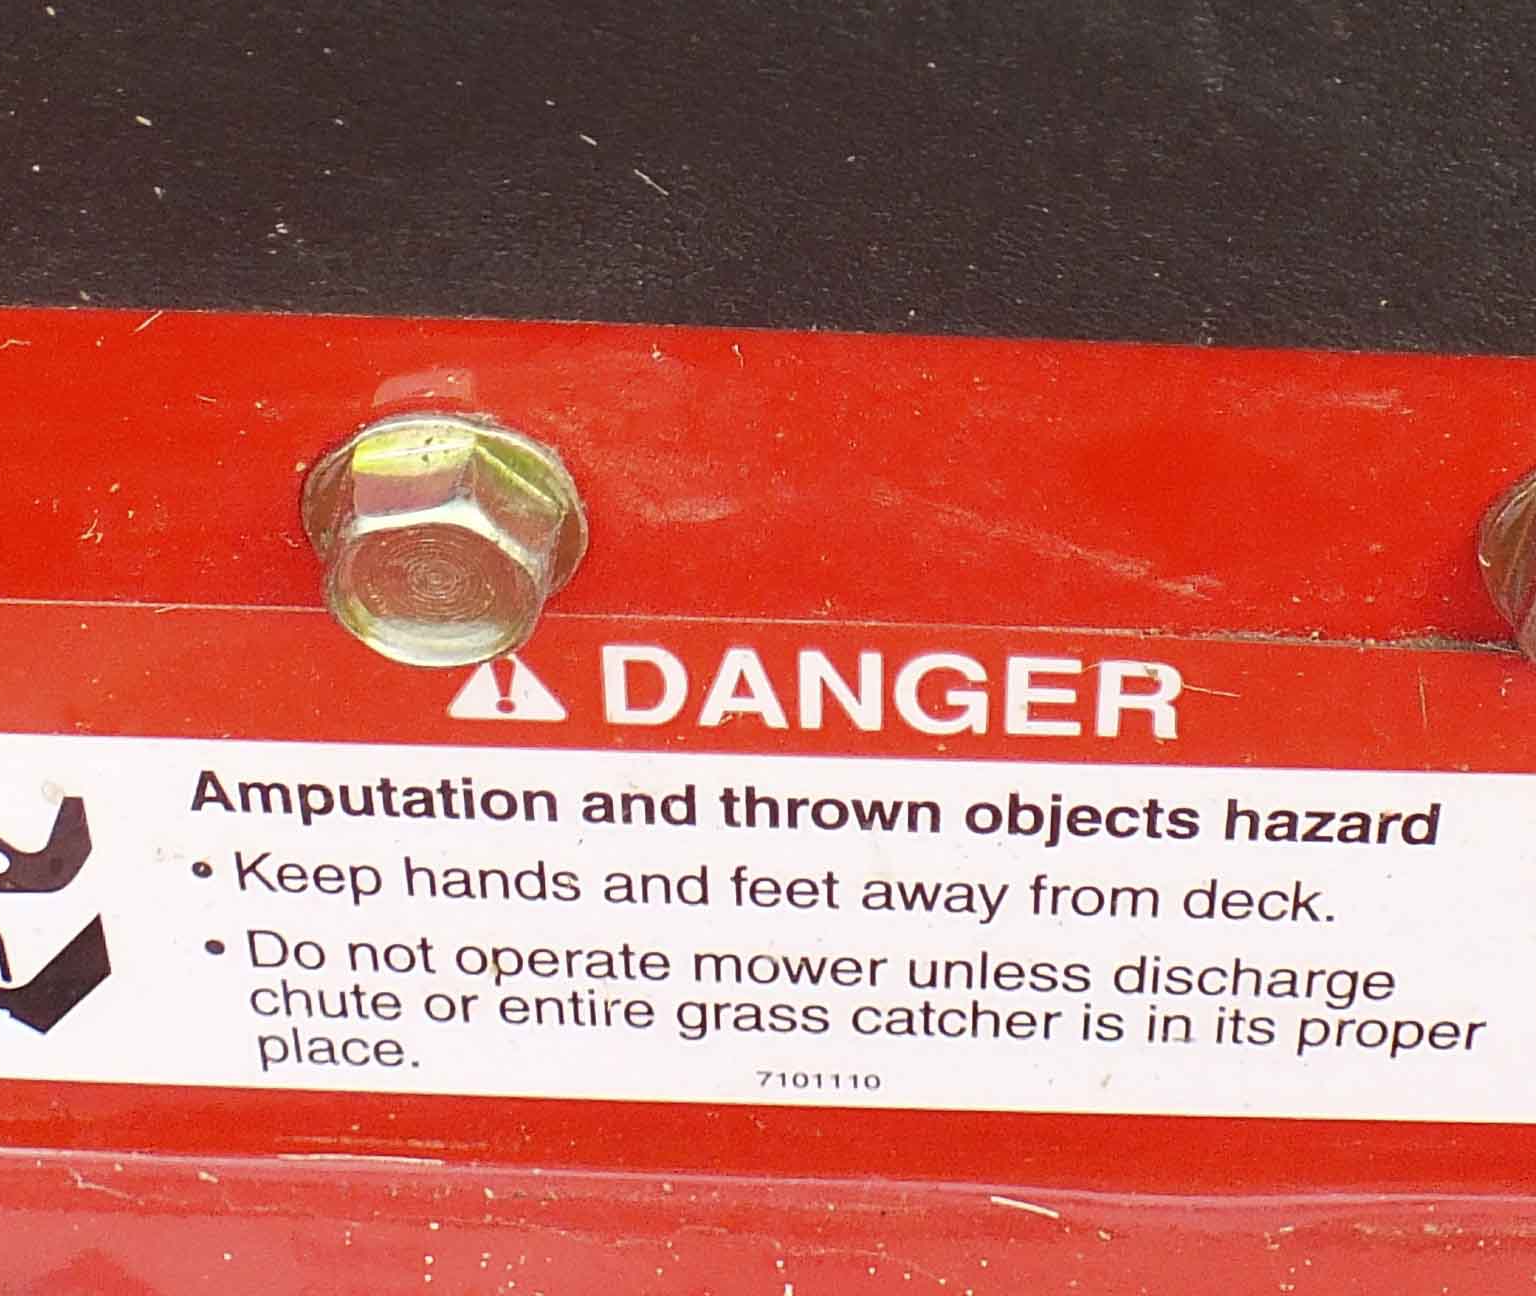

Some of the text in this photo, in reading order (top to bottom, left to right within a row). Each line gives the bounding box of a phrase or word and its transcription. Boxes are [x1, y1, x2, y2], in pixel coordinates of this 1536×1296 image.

[600, 644, 1184, 740] DANGER
[191, 770, 1441, 848] Amputation and thrown objects hazard
[234, 851, 1334, 925] Keep hands and feet away from deck.
[246, 929, 1395, 1009] Do not operate mower unless discharge
[250, 979, 1487, 1059] chute or entire grass catcher is in its proper
[258, 1027, 419, 1072] place.
[756, 1070, 883, 1091] 7101110
